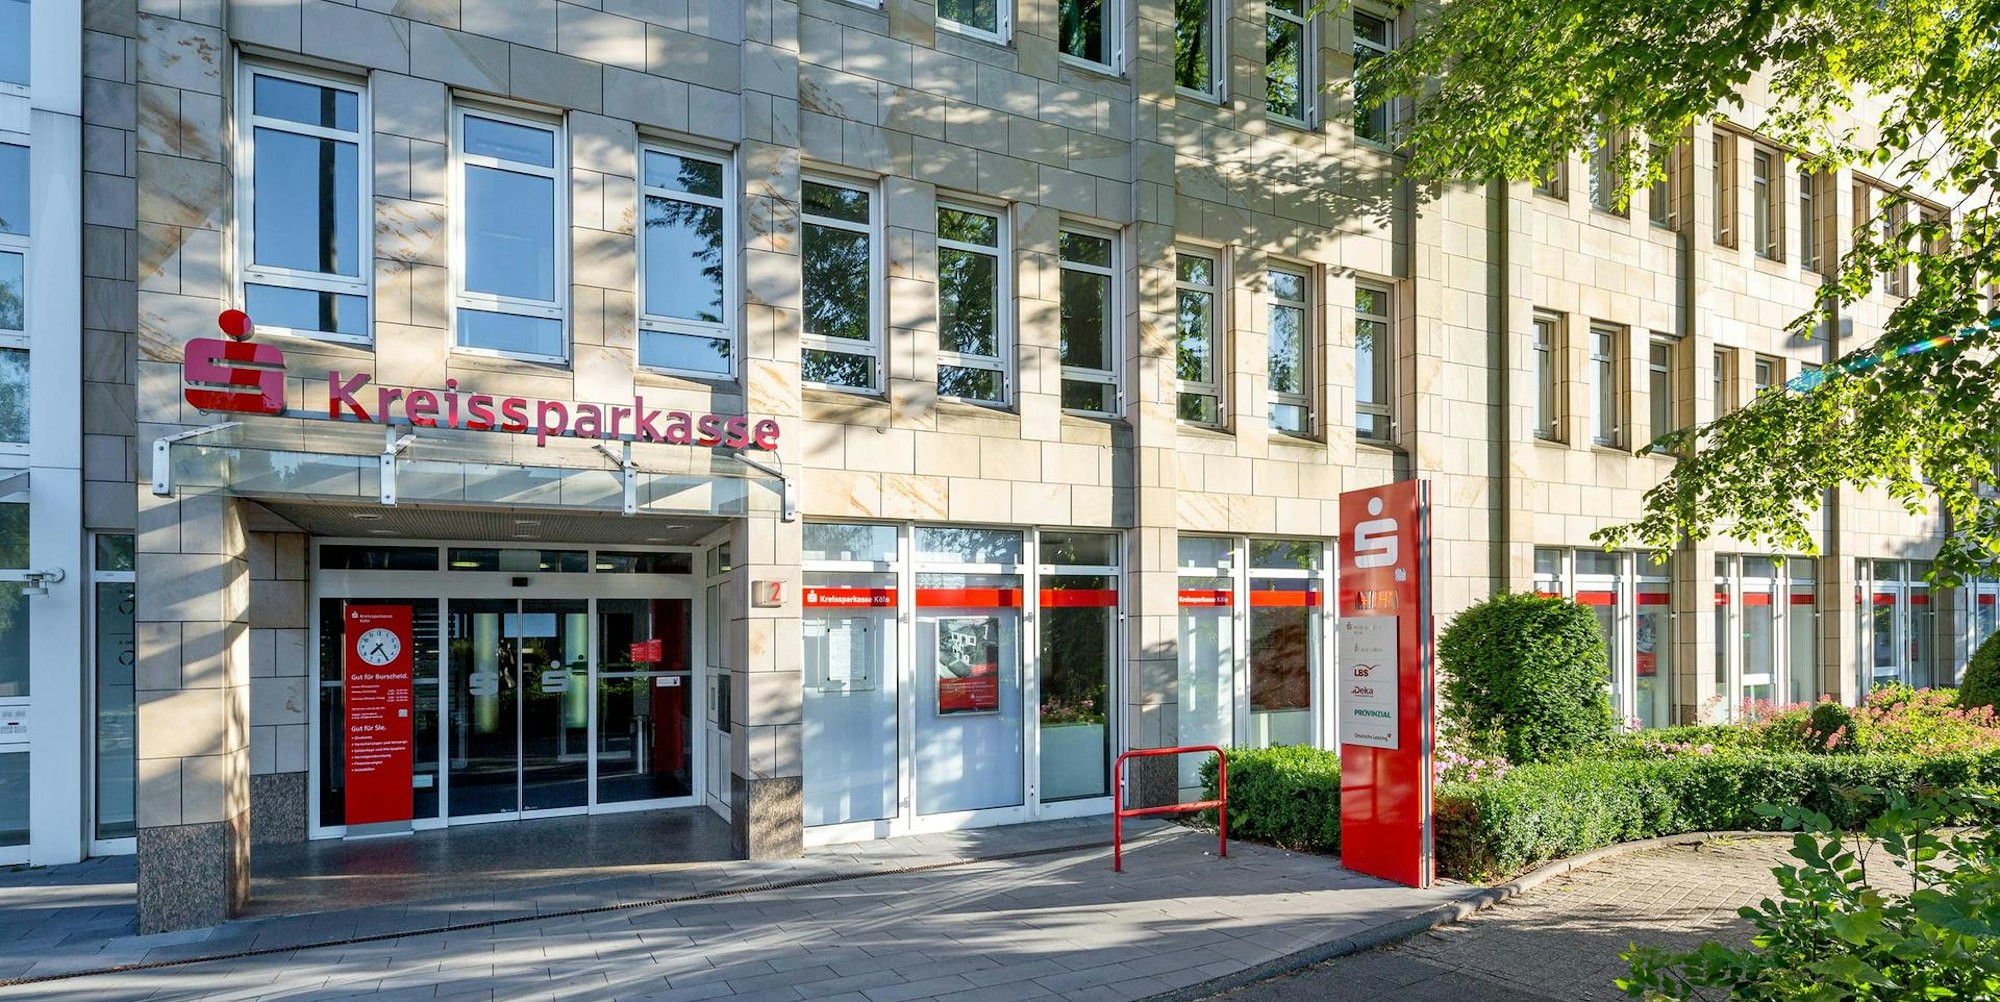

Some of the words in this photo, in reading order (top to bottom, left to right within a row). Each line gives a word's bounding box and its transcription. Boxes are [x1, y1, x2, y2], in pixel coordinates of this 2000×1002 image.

[328, 371, 781, 451] Kreissparkasse
[769, 580, 781, 602] 2
[820, 595, 873, 604] Kreissparkasse
[1354, 669, 1369, 677] LBS
[1354, 686, 1374, 695] Deka
[1354, 709, 1391, 719] PROVINZIAL
